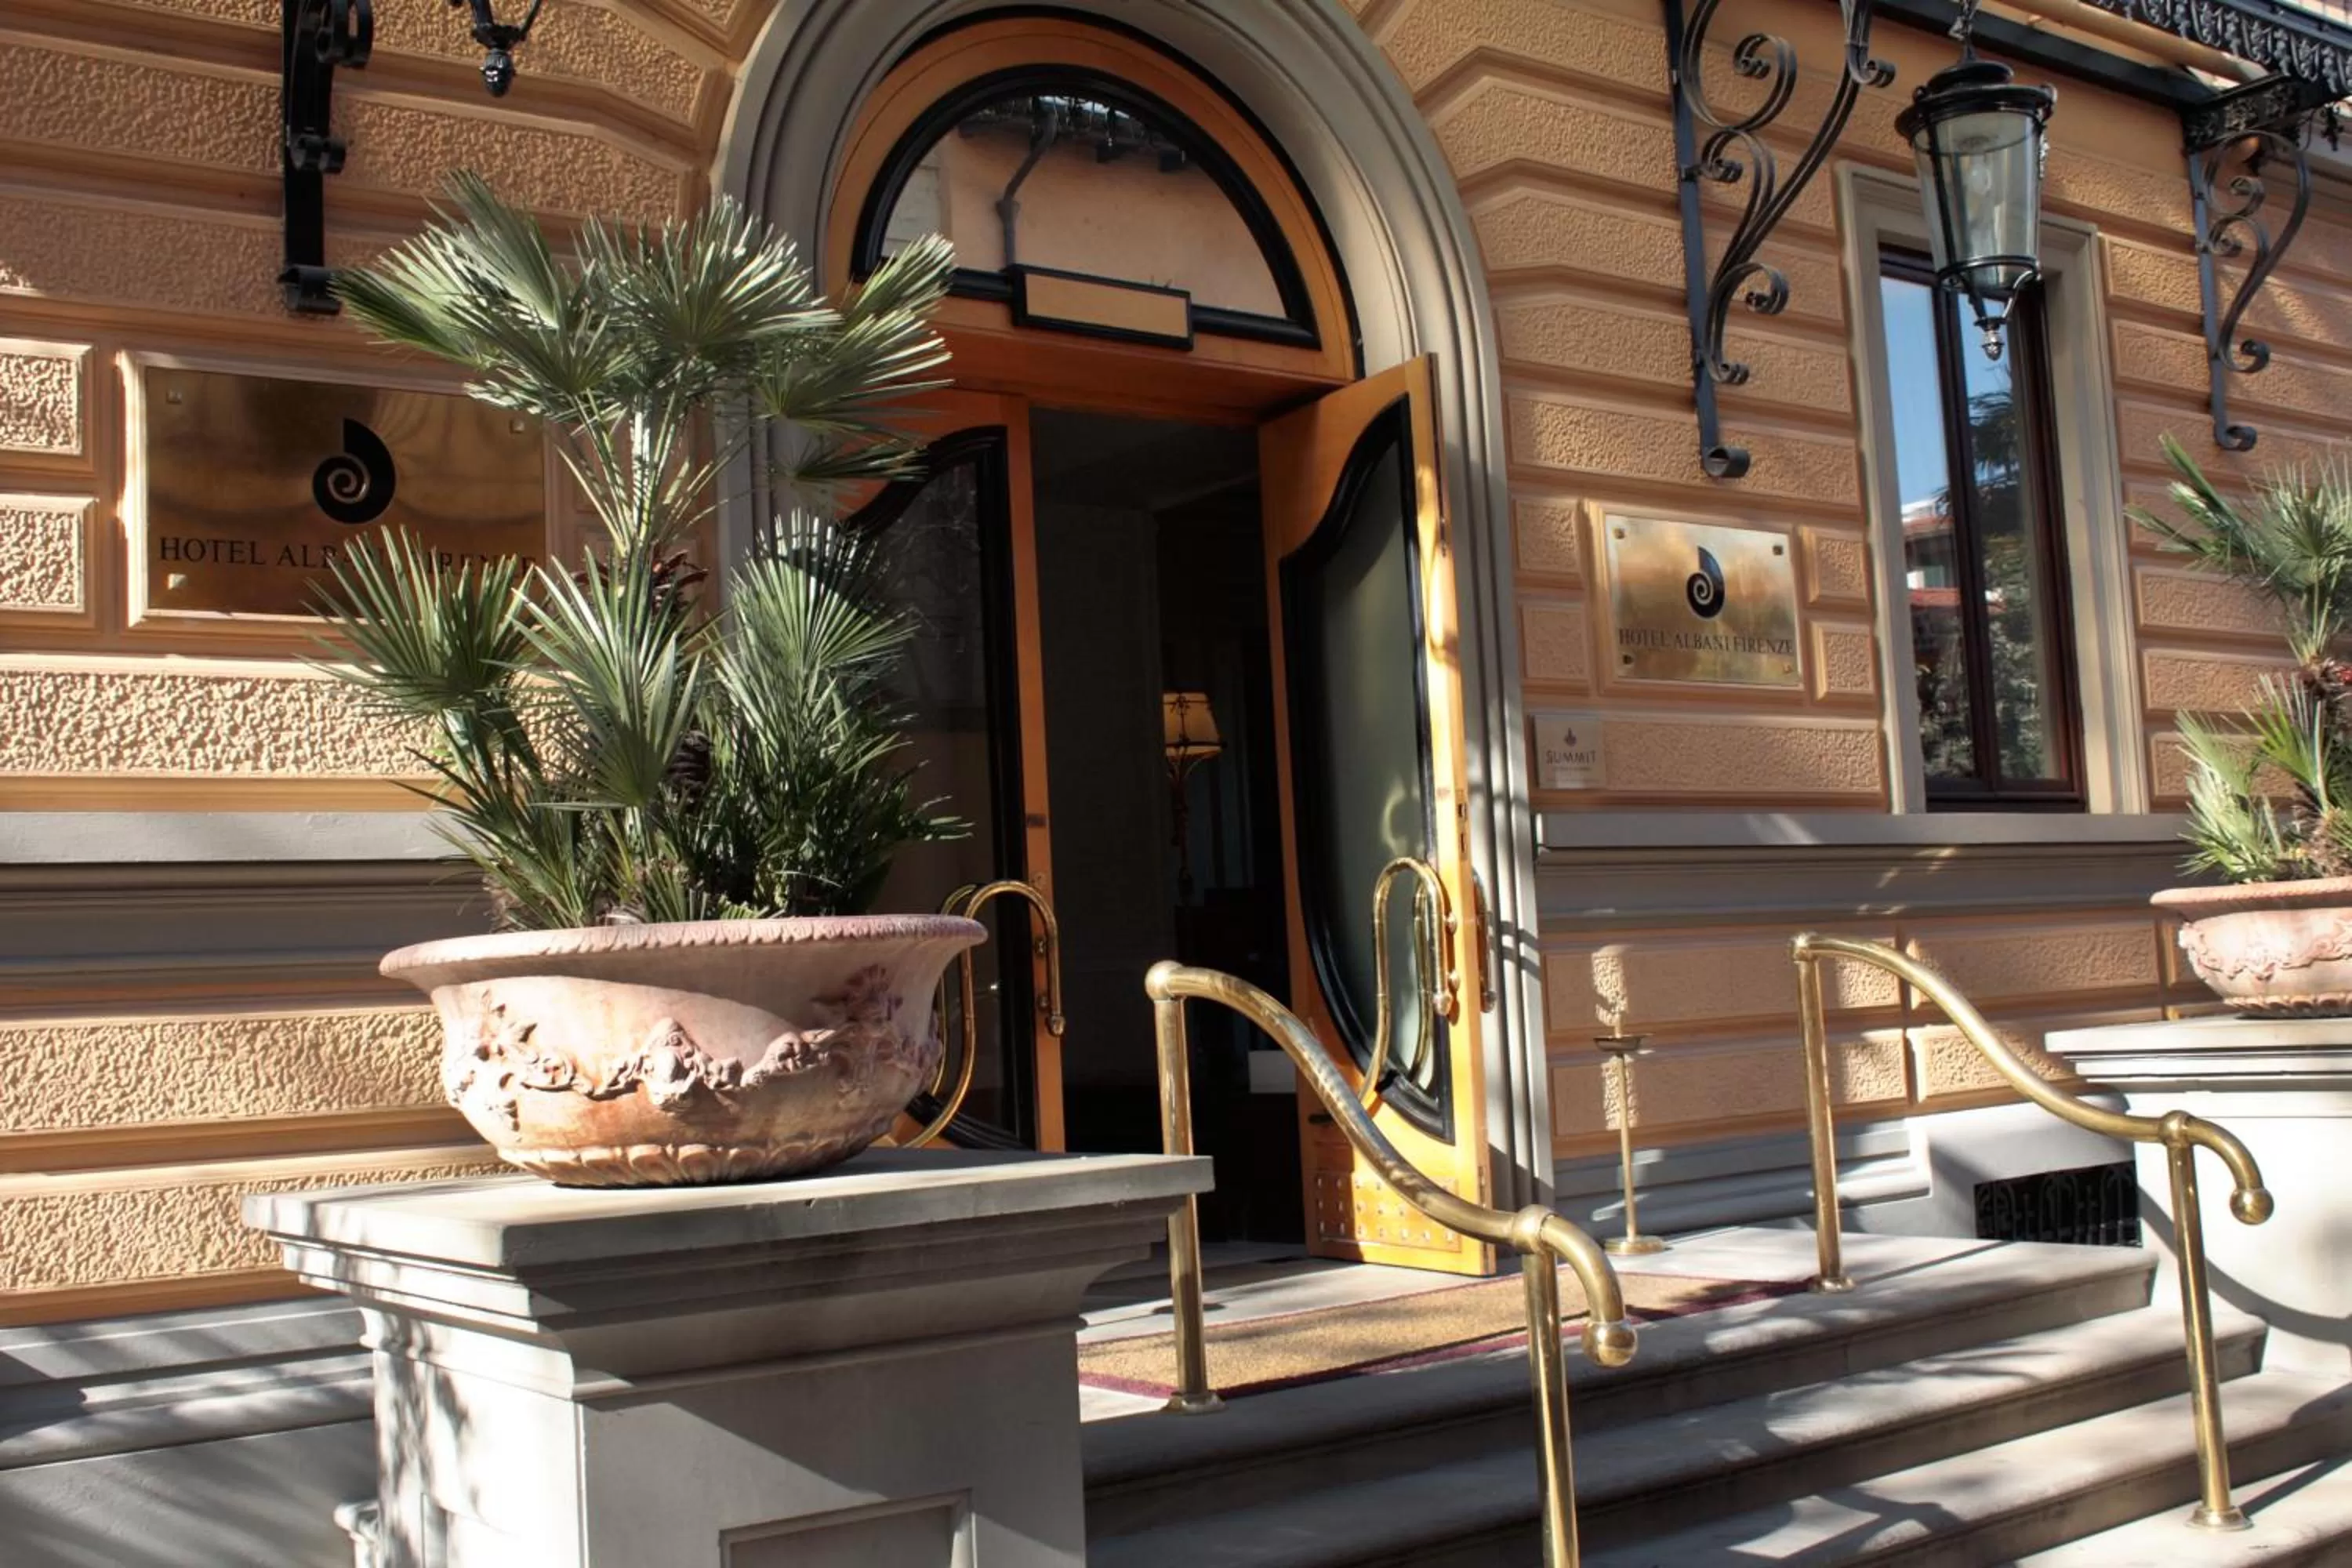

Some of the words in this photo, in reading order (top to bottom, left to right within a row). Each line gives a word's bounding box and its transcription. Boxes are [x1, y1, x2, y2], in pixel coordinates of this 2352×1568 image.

[159, 537, 267, 566] HOTEL
[276, 543, 397, 573] ALB
[1618, 628, 1669, 648] HOTEL
[1673, 631, 1730, 652] ALBANI
[1733, 635, 1795, 655] FIRENZE
[1545, 749, 1596, 766] SUMMIT
